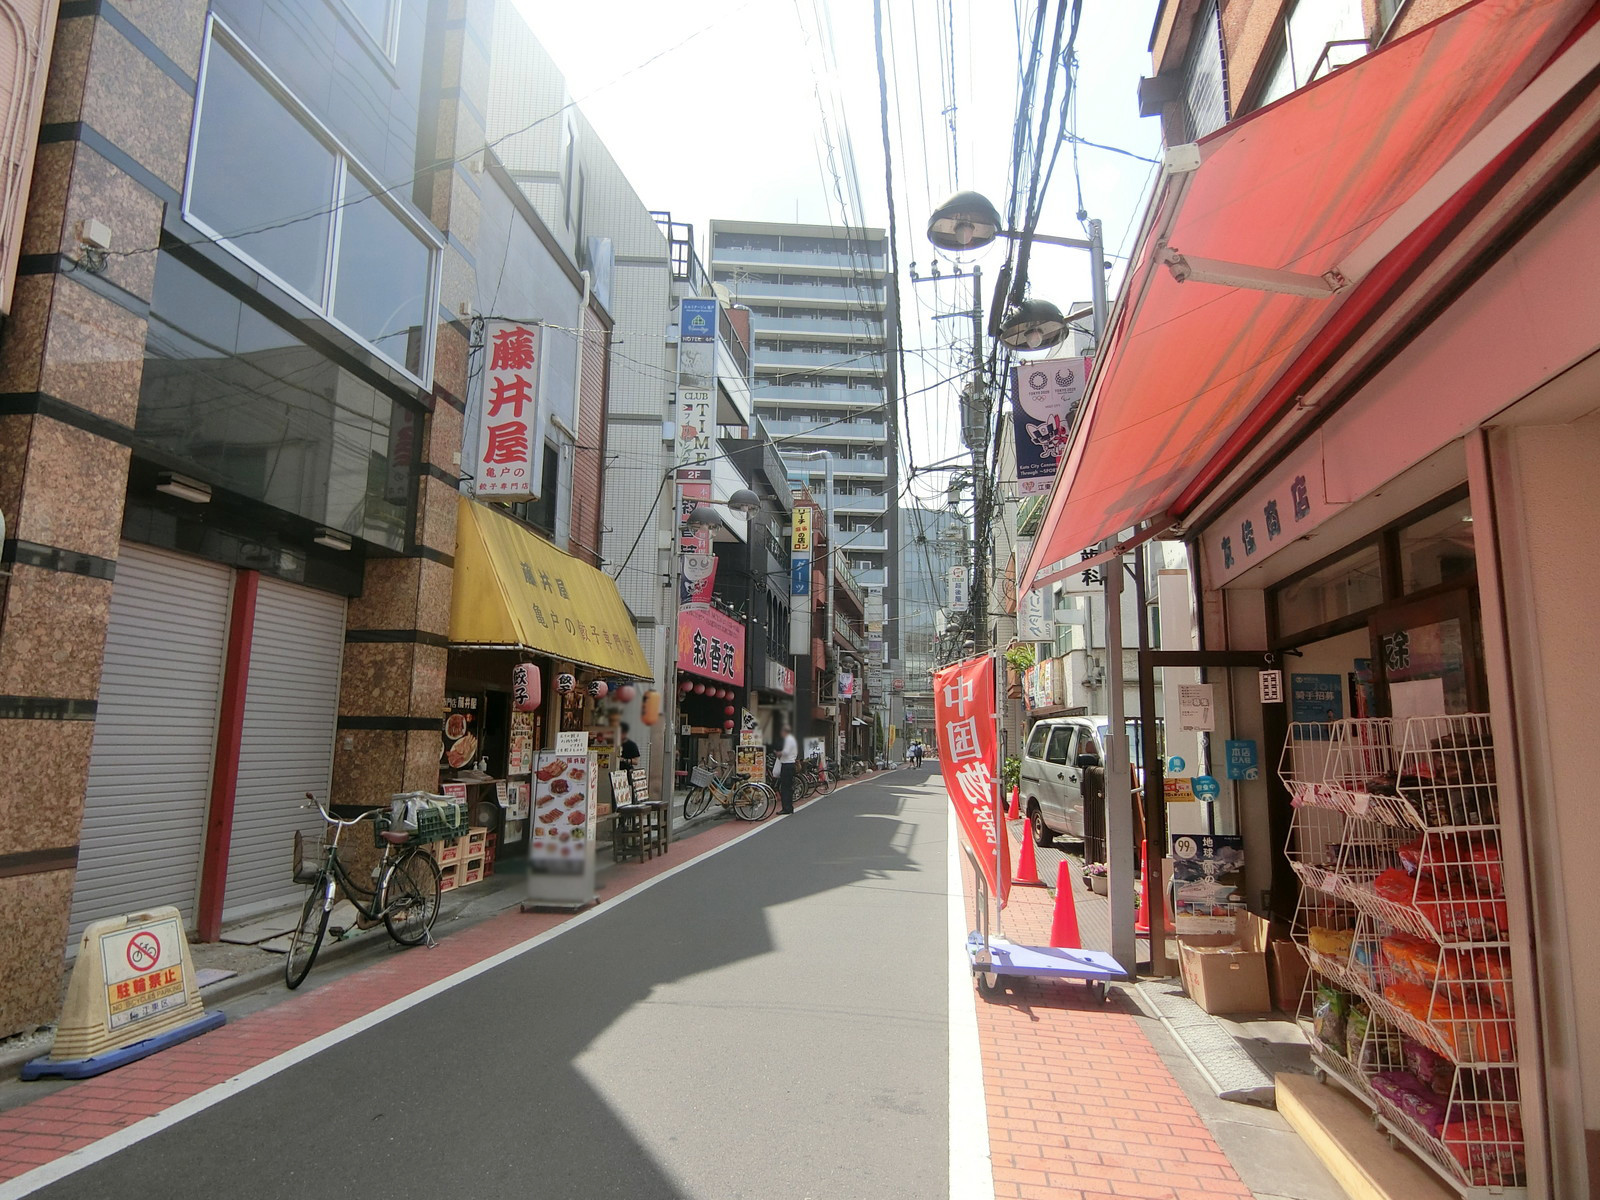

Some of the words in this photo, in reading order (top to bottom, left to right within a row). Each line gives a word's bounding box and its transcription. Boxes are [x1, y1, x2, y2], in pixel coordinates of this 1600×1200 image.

[483, 326, 535, 465] 藤井屋
[694, 403, 710, 467] TIME
[486, 466, 525, 478] 亀戸の
[687, 471, 701, 479] 2F
[479, 482, 529, 491] 餃子専門店
[520, 561, 570, 601] 藤井屋
[693, 627, 735, 679] 叙香苑
[112, 1003, 123, 1011] NO
[156, 984, 183, 998] PARKING
[116, 969, 177, 999] 駐輪禁止
[142, 999, 170, 1016] 江東区
